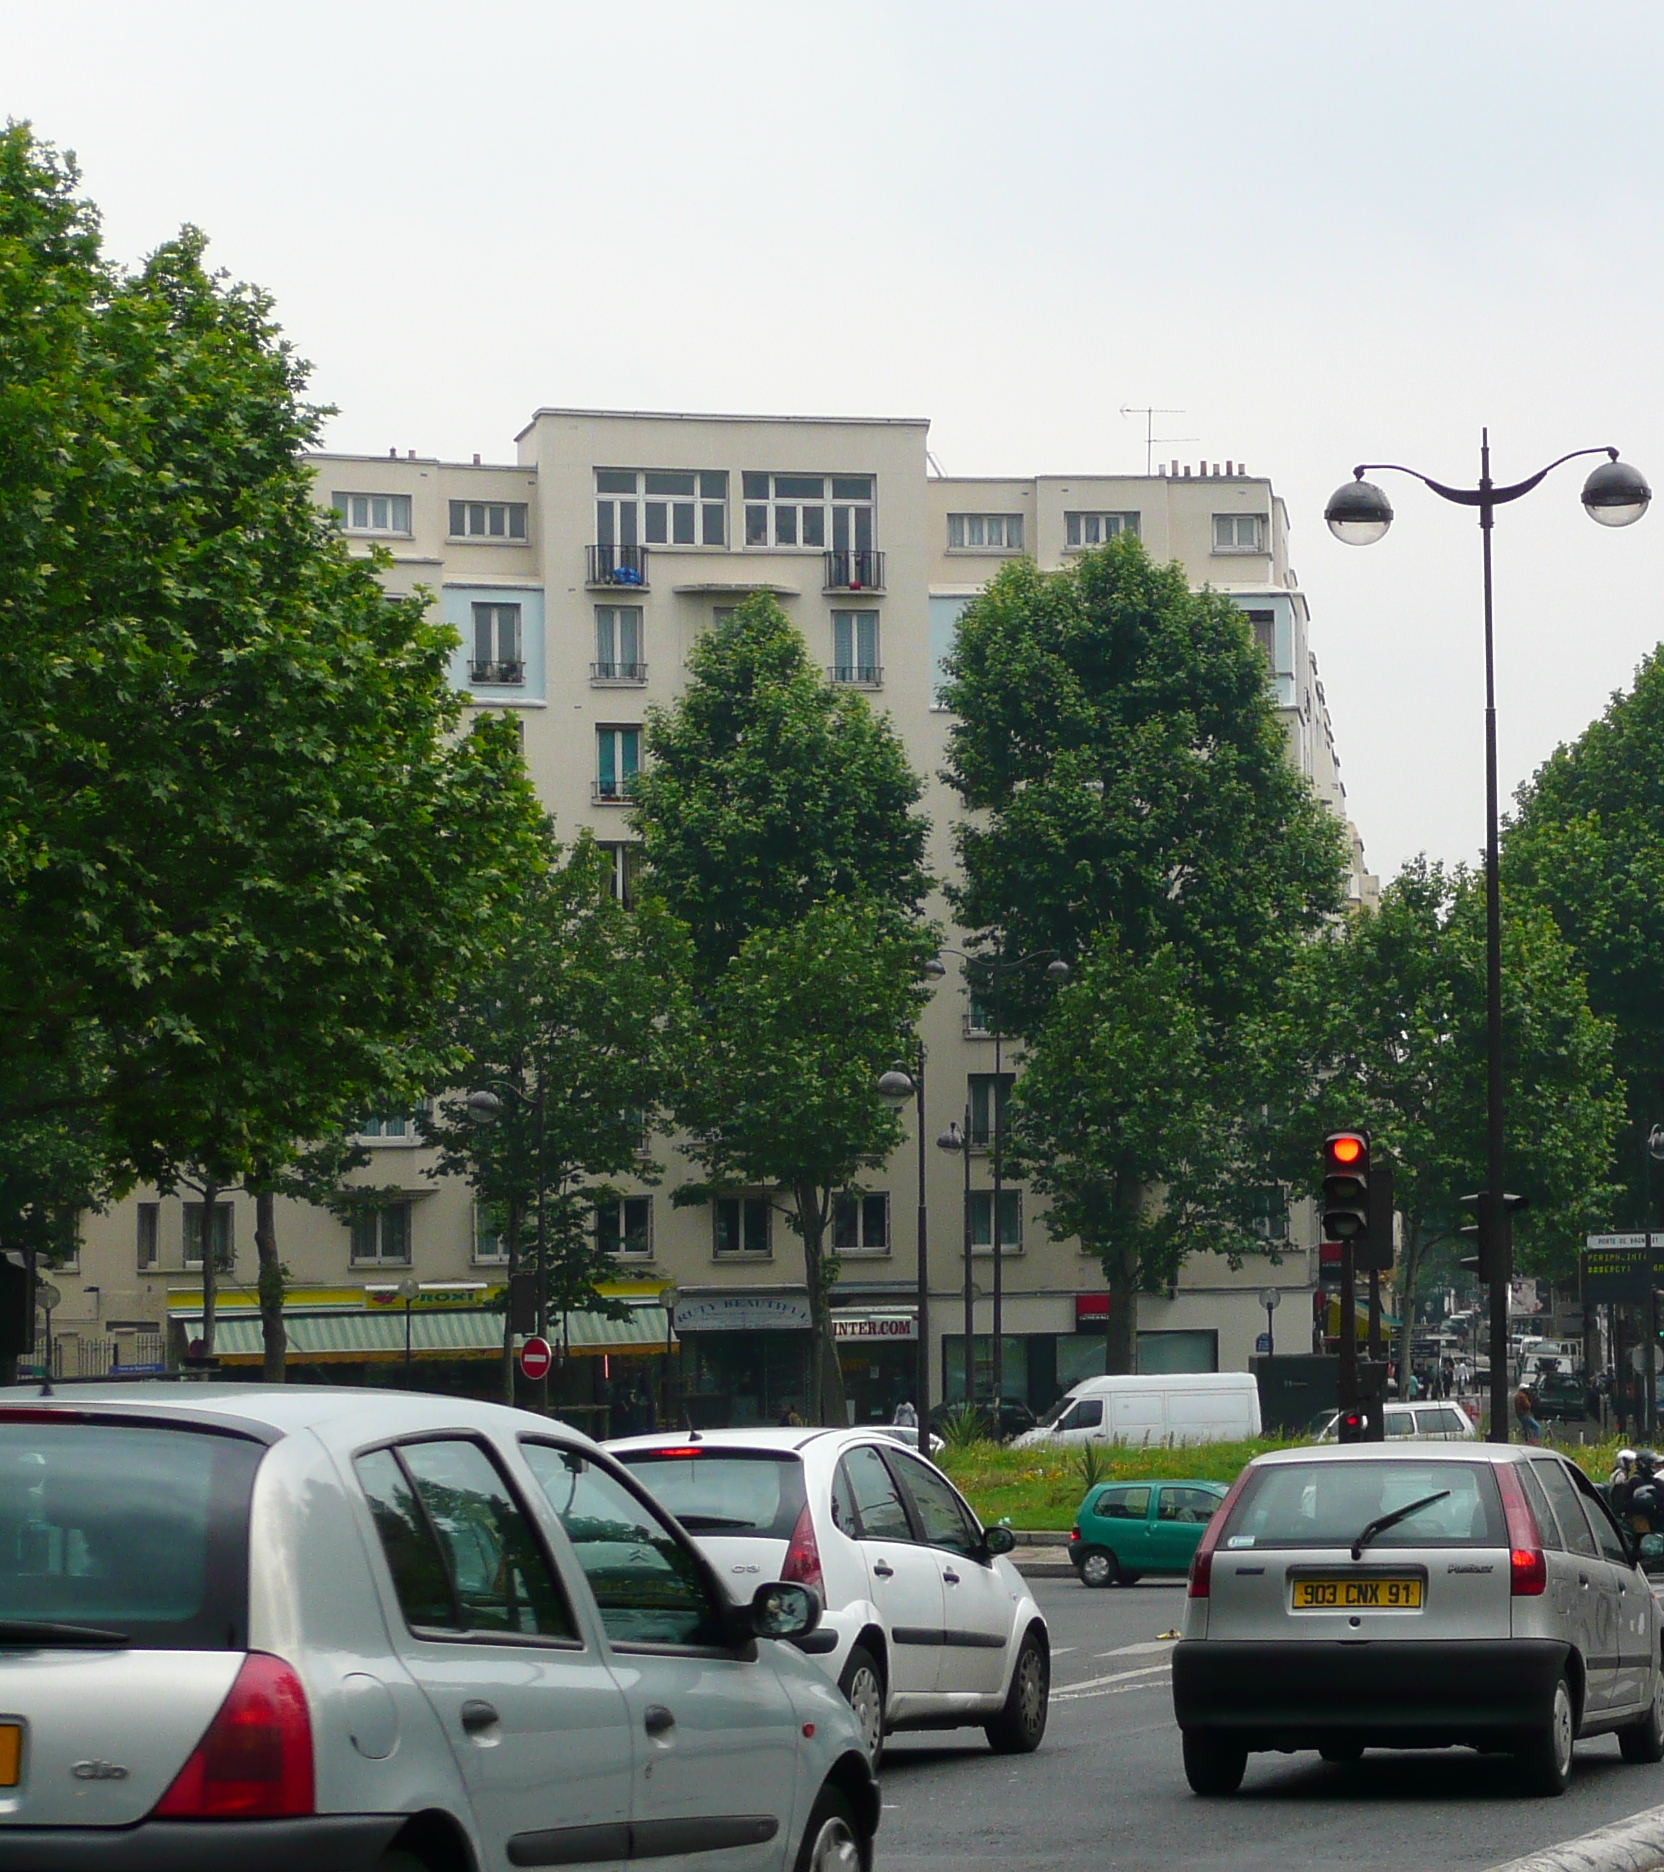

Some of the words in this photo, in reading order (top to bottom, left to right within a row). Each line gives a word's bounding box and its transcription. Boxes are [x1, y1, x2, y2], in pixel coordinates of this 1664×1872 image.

[1304, 1585, 1337, 1604] 903
[1346, 1584, 1380, 1604] CNX
[1388, 1584, 1411, 1604] 91
